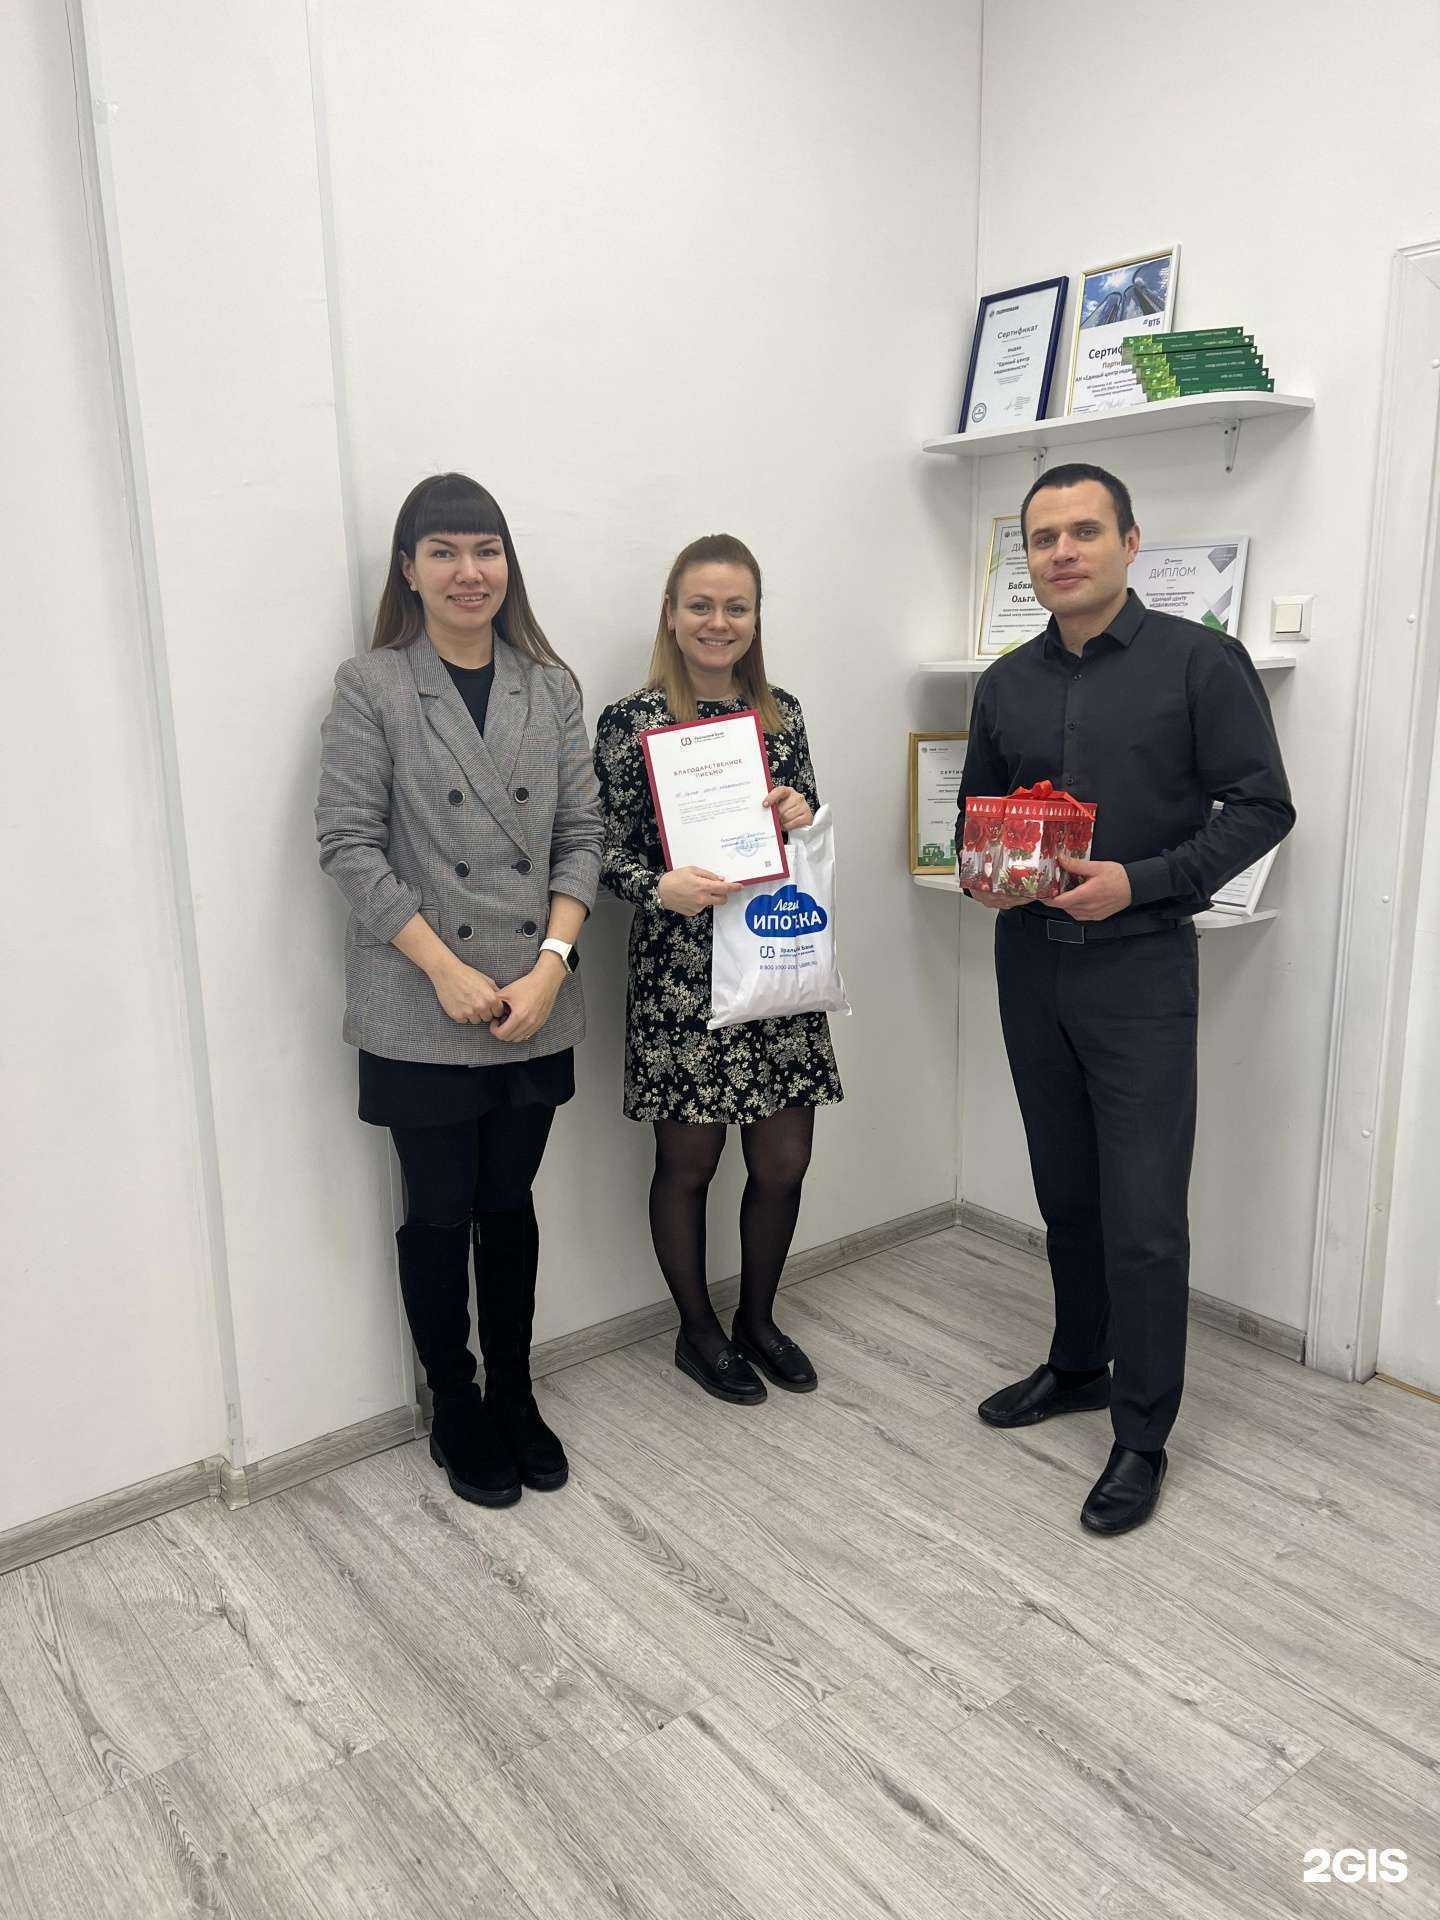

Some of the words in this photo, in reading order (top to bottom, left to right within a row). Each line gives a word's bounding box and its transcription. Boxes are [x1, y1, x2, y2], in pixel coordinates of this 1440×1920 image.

[997, 324, 1039, 339] Сертификат
[1102, 361, 1122, 369] Парти
[1149, 567, 1196, 579] ДИПЛОМ
[1007, 581, 1033, 590] Бабки
[1011, 594, 1036, 603] Ольга
[674, 759, 743, 776] БЛАГОДАРСТВЕННОЕ
[695, 768, 724, 778] ПИСЬМО
